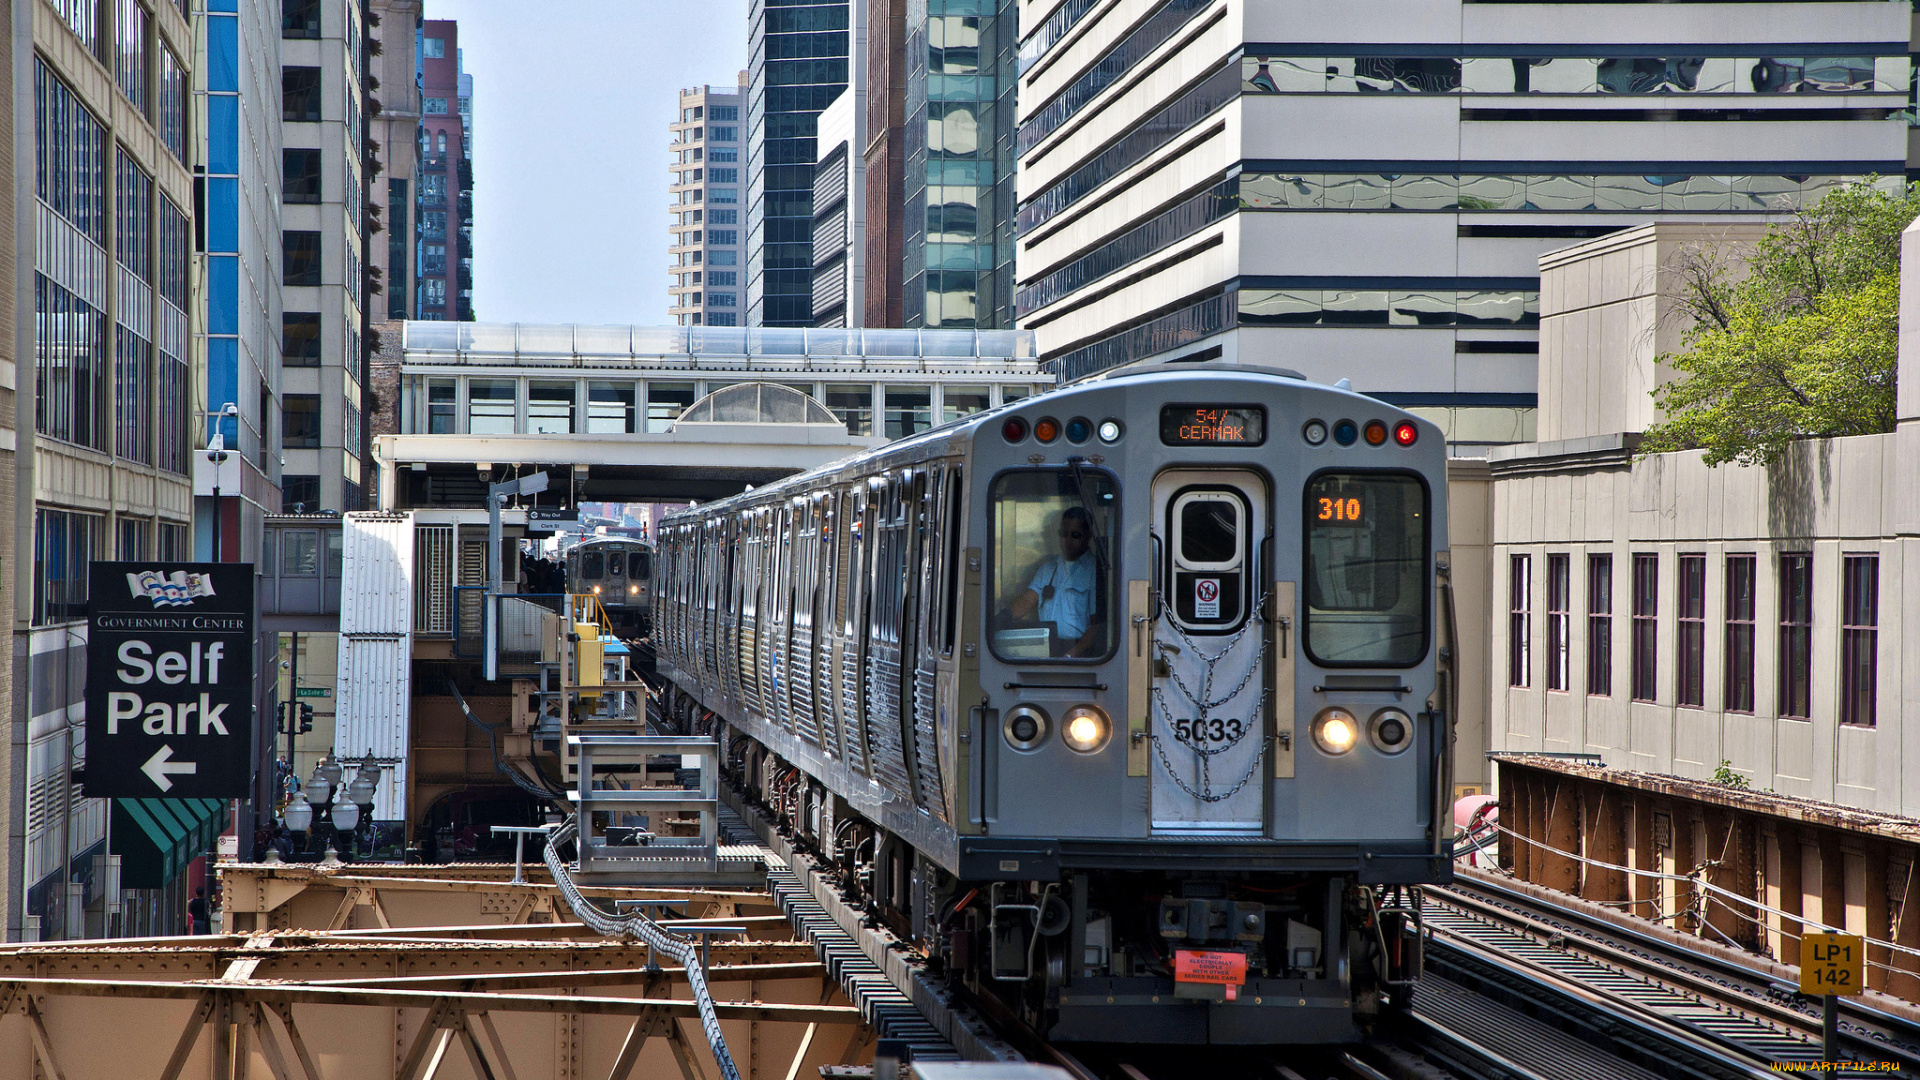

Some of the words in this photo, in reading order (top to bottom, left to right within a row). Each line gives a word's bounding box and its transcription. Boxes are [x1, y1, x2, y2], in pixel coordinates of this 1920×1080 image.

[1196, 409, 1228, 426] 54/
[1180, 426, 1244, 440] CERMAK
[1318, 498, 1360, 520] 310
[116, 640, 224, 685] Self
[107, 692, 230, 736] Park
[1174, 718, 1242, 742] 5033
[1814, 944, 1850, 962] LP1
[1814, 968, 1850, 985] 142
